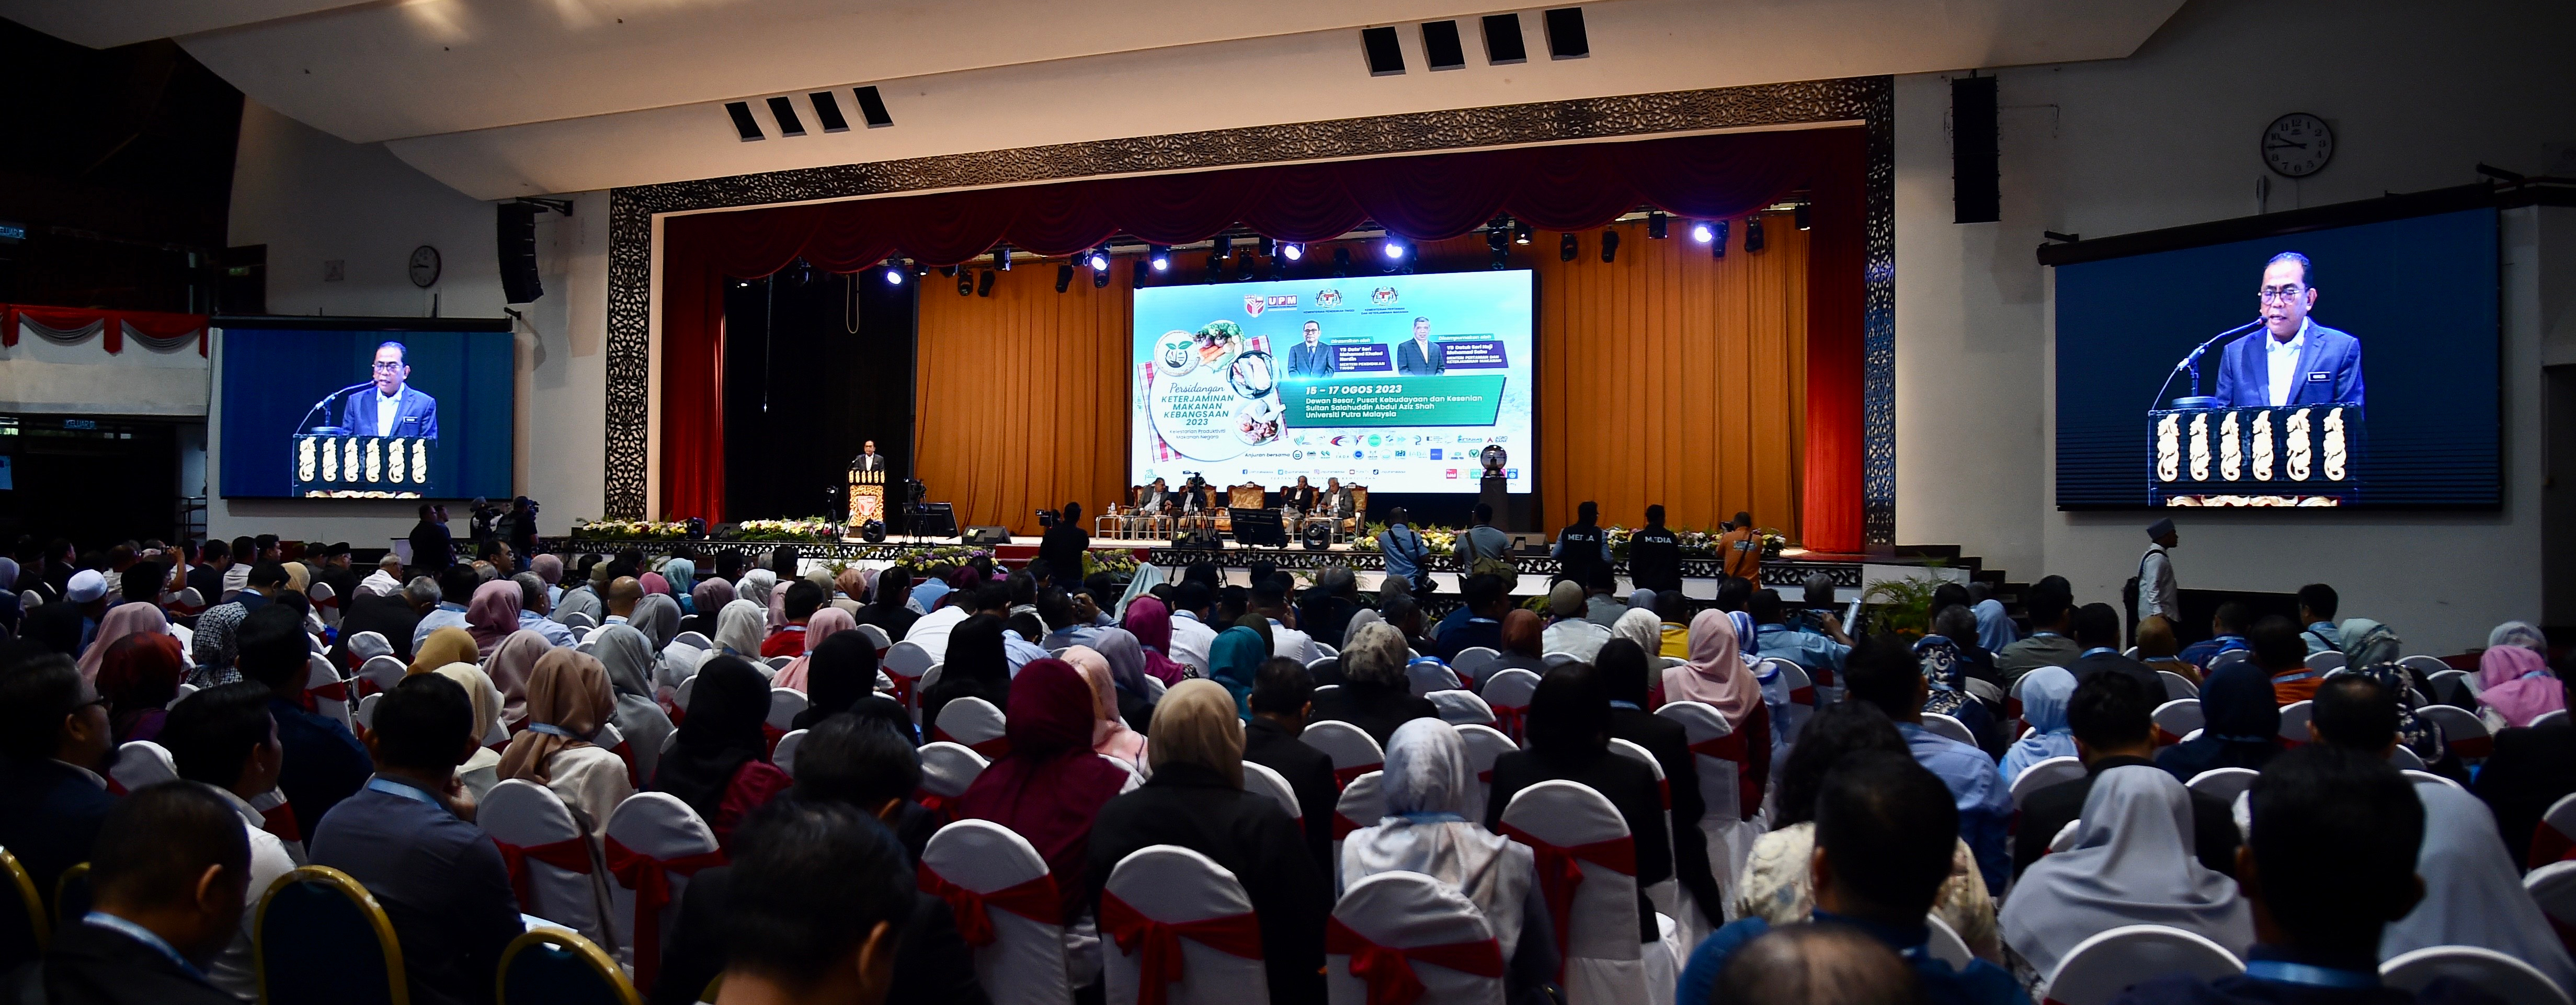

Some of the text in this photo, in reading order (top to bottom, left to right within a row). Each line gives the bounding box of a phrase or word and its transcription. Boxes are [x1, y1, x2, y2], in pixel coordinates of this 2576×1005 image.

[1268, 296, 1296, 305] UPM
[1170, 382, 1225, 395] Persidangan
[1306, 386, 1317, 395] 15
[1328, 386, 1340, 395] 17
[1341, 385, 1373, 394] OGOS
[1375, 384, 1403, 394] 2023
[1380, 396, 1429, 404] Kebudayaan
